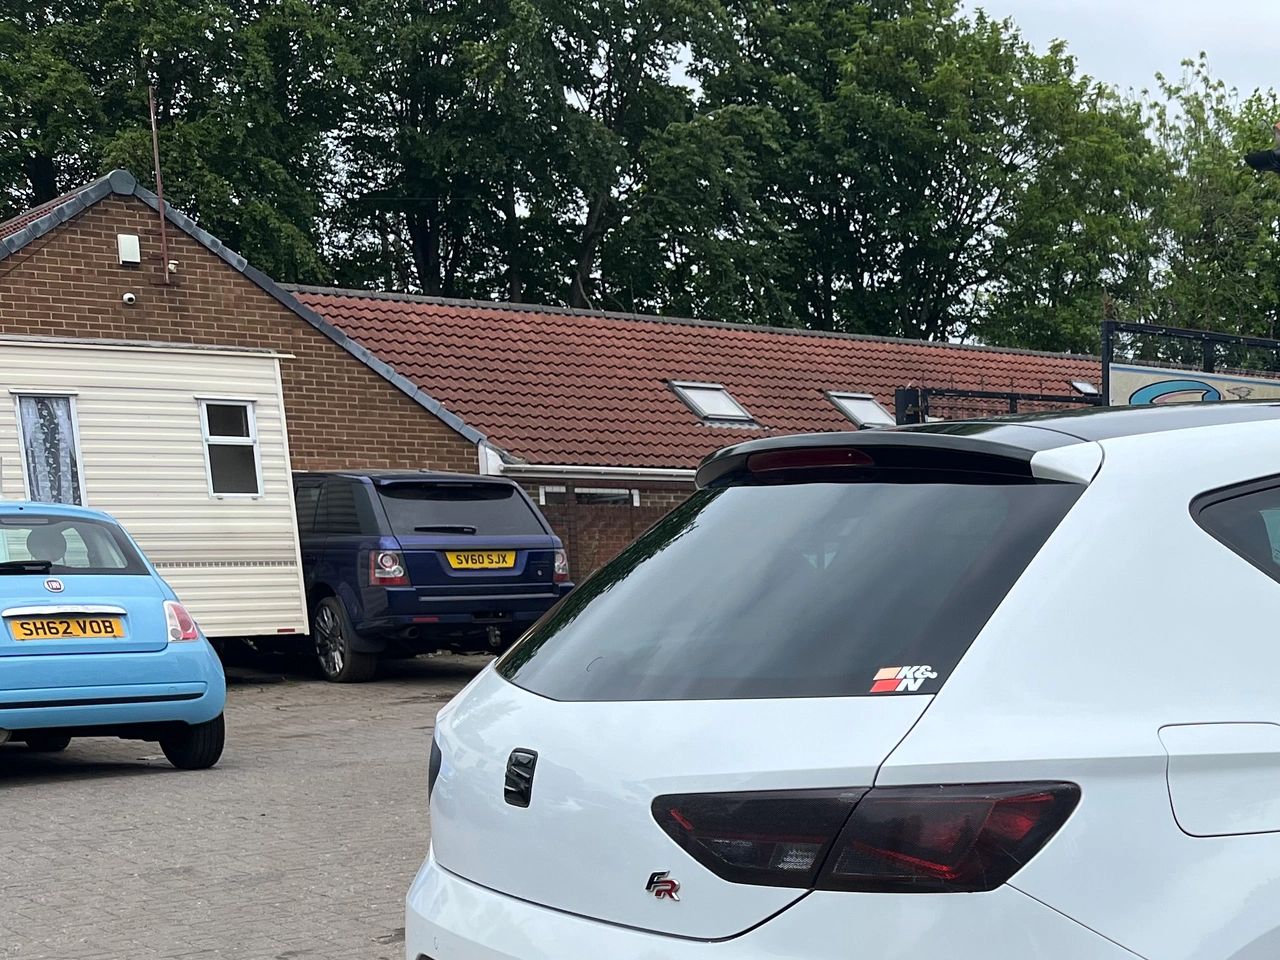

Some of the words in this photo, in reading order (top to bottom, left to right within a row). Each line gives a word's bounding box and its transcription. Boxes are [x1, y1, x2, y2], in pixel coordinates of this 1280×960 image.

[456, 554, 485, 564] SV60
[487, 554, 507, 564] SJX
[20, 620, 73, 636] SH62
[76, 619, 115, 634] VOB
[645, 870, 680, 901] FR
